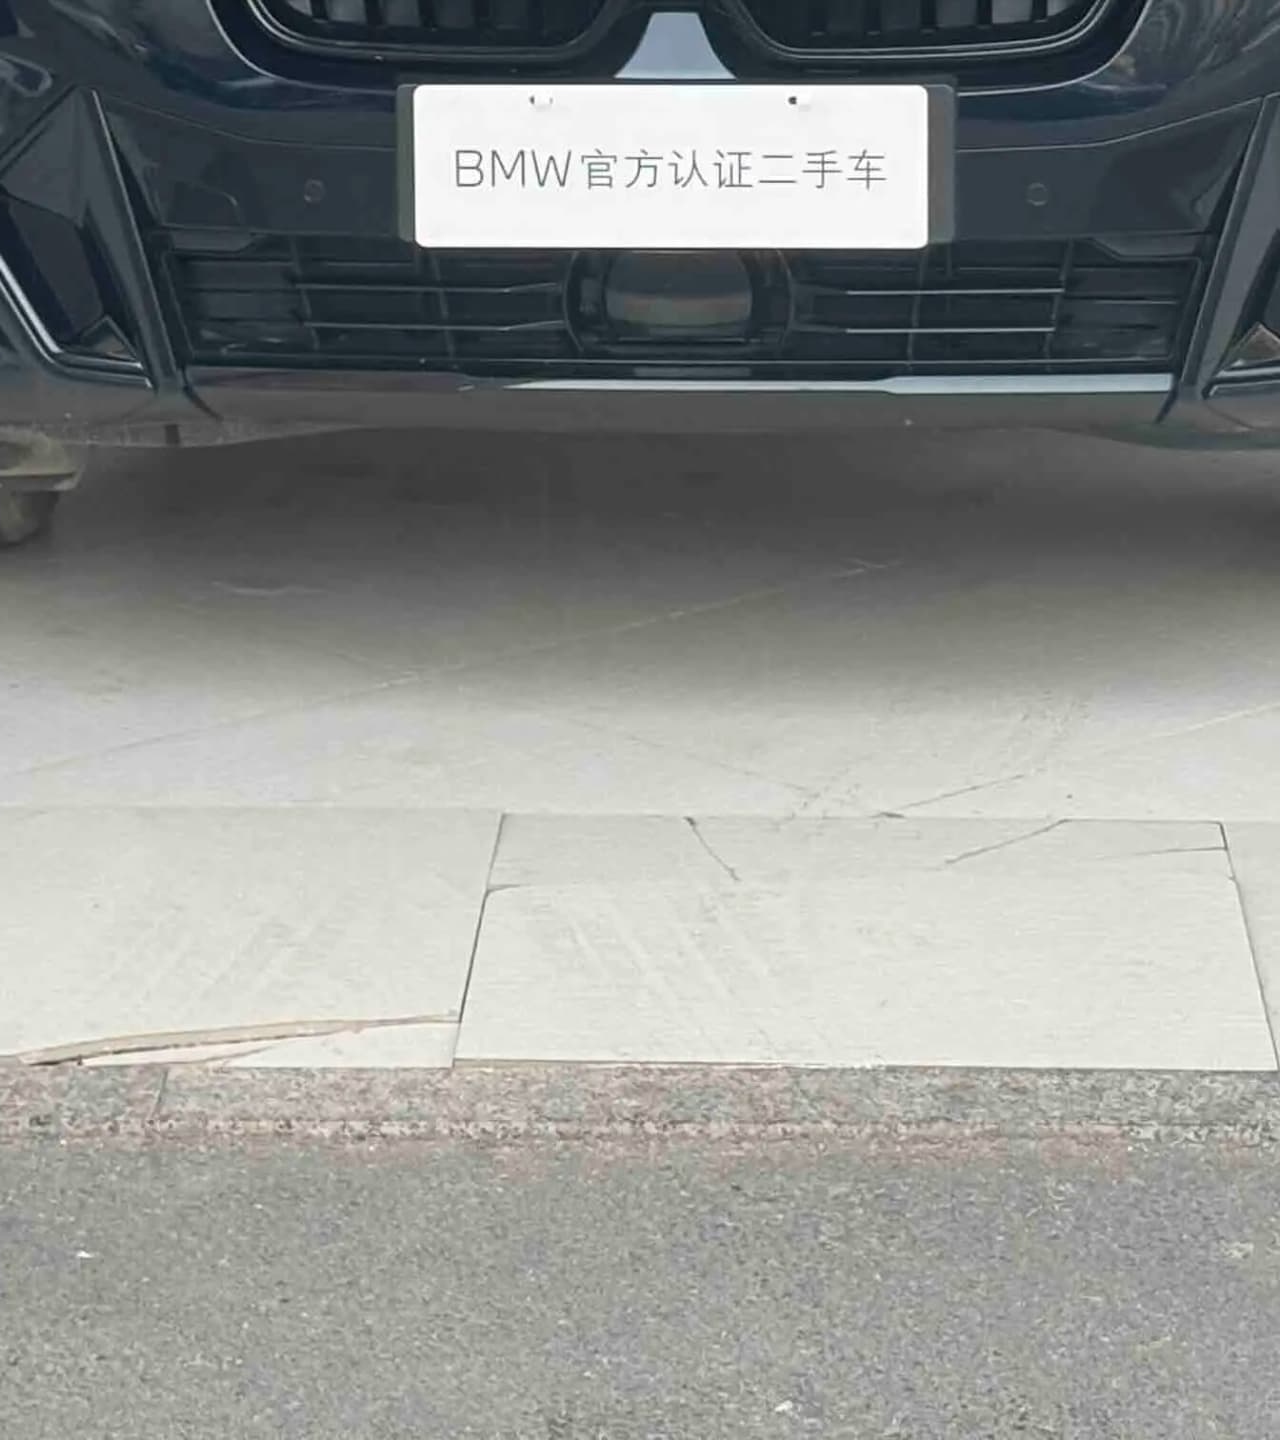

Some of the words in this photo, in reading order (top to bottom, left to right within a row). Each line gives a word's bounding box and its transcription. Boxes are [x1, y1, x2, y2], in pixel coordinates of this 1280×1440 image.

[454, 147, 888, 191] BMW官方认证二手车
